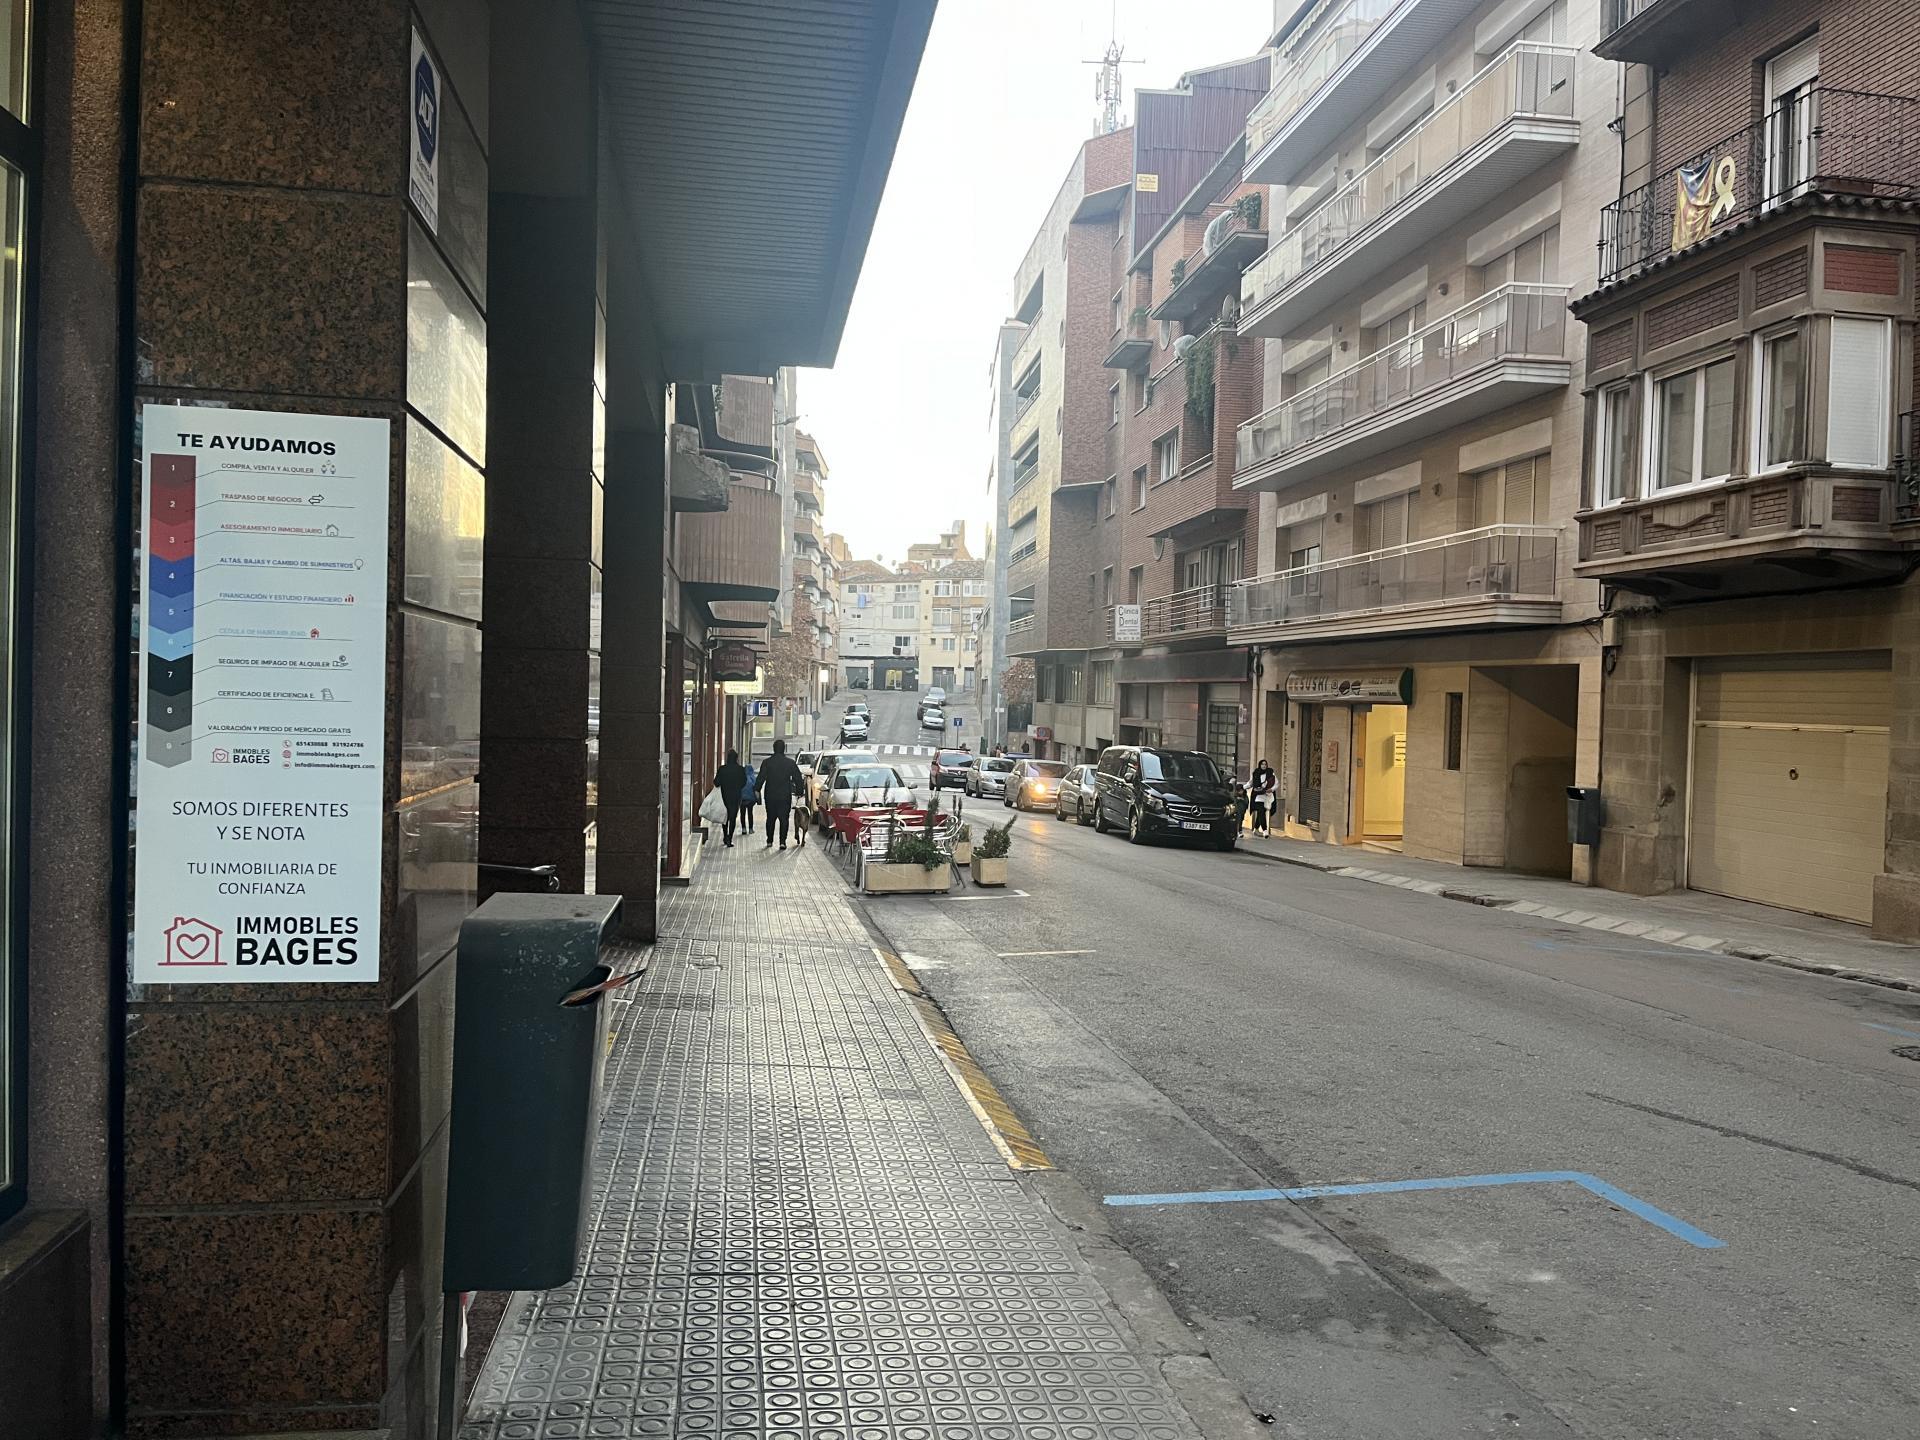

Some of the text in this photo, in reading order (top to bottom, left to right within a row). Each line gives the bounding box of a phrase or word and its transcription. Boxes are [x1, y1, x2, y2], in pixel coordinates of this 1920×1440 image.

[419, 91, 434, 135] ADT
[177, 433, 336, 456] TE AYUDAMOS
[221, 463, 251, 471] COMPRA,
[282, 466, 314, 474] ALQUILER
[220, 524, 276, 532] ASESORAMIENTO
[219, 592, 266, 600] FINANCIACIÓN
[1119, 617, 1138, 626] Dental
[208, 724, 251, 732] VALORACIÓN
[233, 755, 270, 764] BAGES
[296, 751, 359, 759] immoblesbages.com
[295, 762, 375, 770] info@immoblesbages.com
[172, 801, 349, 817] SOMOS DIFERENTES
[217, 826, 305, 840] Y SE NOTA
[187, 862, 337, 874] TU INMOBILIARIA DE
[219, 883, 305, 895] CONFIANZA
[237, 917, 359, 934] IMMOBLES
[236, 938, 357, 966] BAGES
